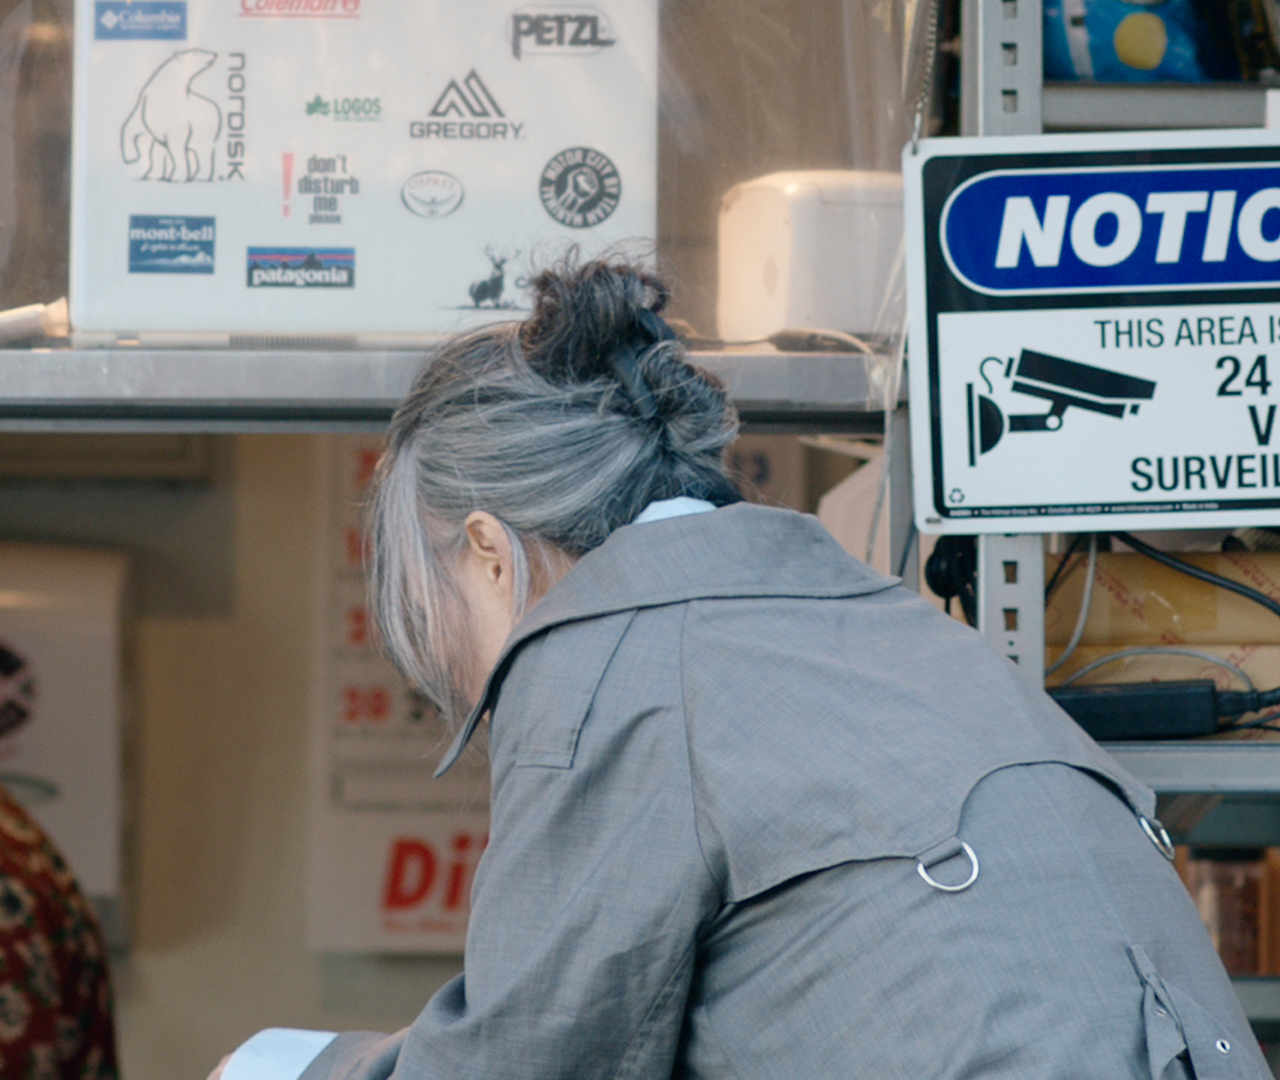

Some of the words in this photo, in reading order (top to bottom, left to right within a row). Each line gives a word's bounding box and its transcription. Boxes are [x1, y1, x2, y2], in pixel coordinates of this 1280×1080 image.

[512, 14, 616, 60] PETZL
[333, 97, 382, 115] LOGOS
[409, 121, 524, 140] GREGORY
[307, 154, 348, 174] don't
[298, 174, 360, 195] disturb
[313, 195, 338, 212] me
[253, 267, 348, 286] patagonia
[1094, 318, 1165, 349] THIS
[1175, 316, 1258, 347] AREA
[1216, 355, 1272, 397] 24
